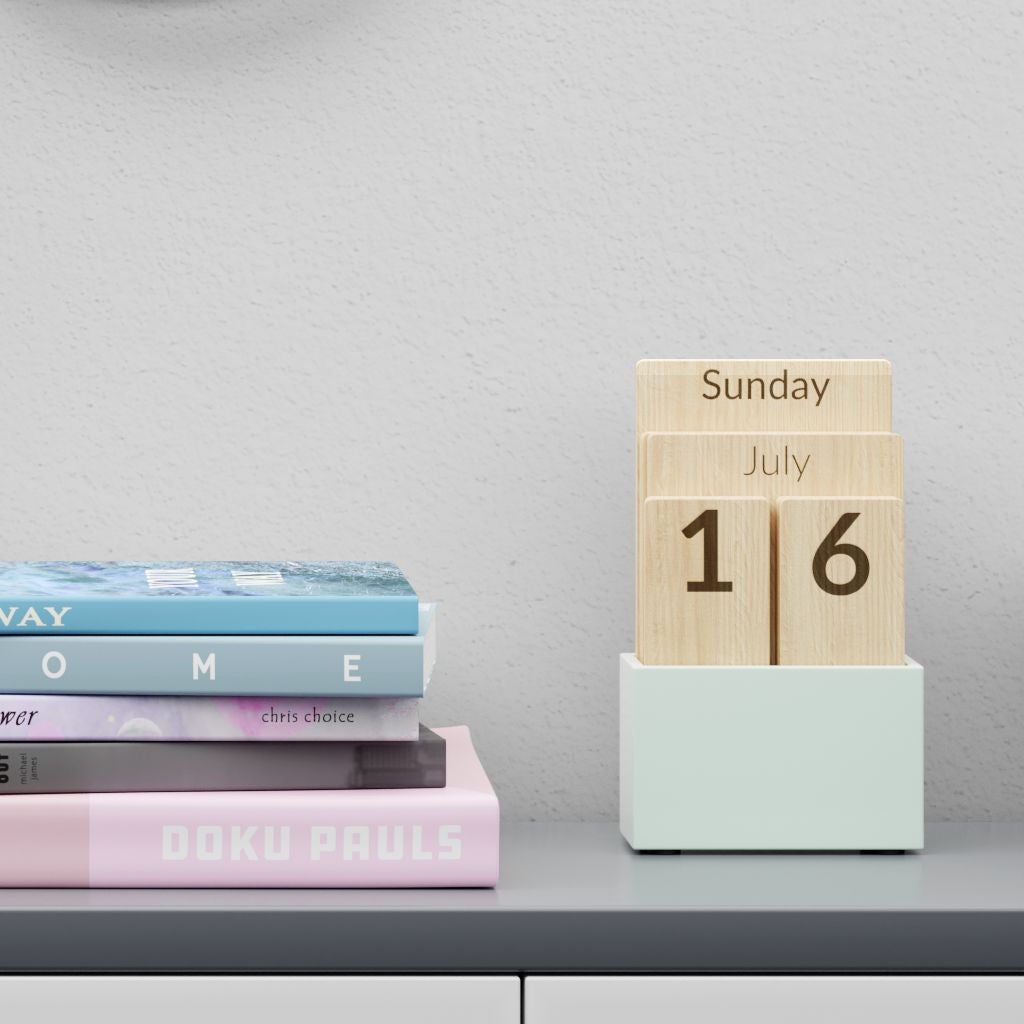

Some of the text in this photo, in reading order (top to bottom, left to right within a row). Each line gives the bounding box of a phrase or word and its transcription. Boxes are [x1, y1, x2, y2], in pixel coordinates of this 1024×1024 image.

[702, 368, 831, 406] Sunday
[743, 445, 811, 482] July
[261, 707, 355, 724] chris choice
[161, 824, 463, 862] DOKU PAULS
